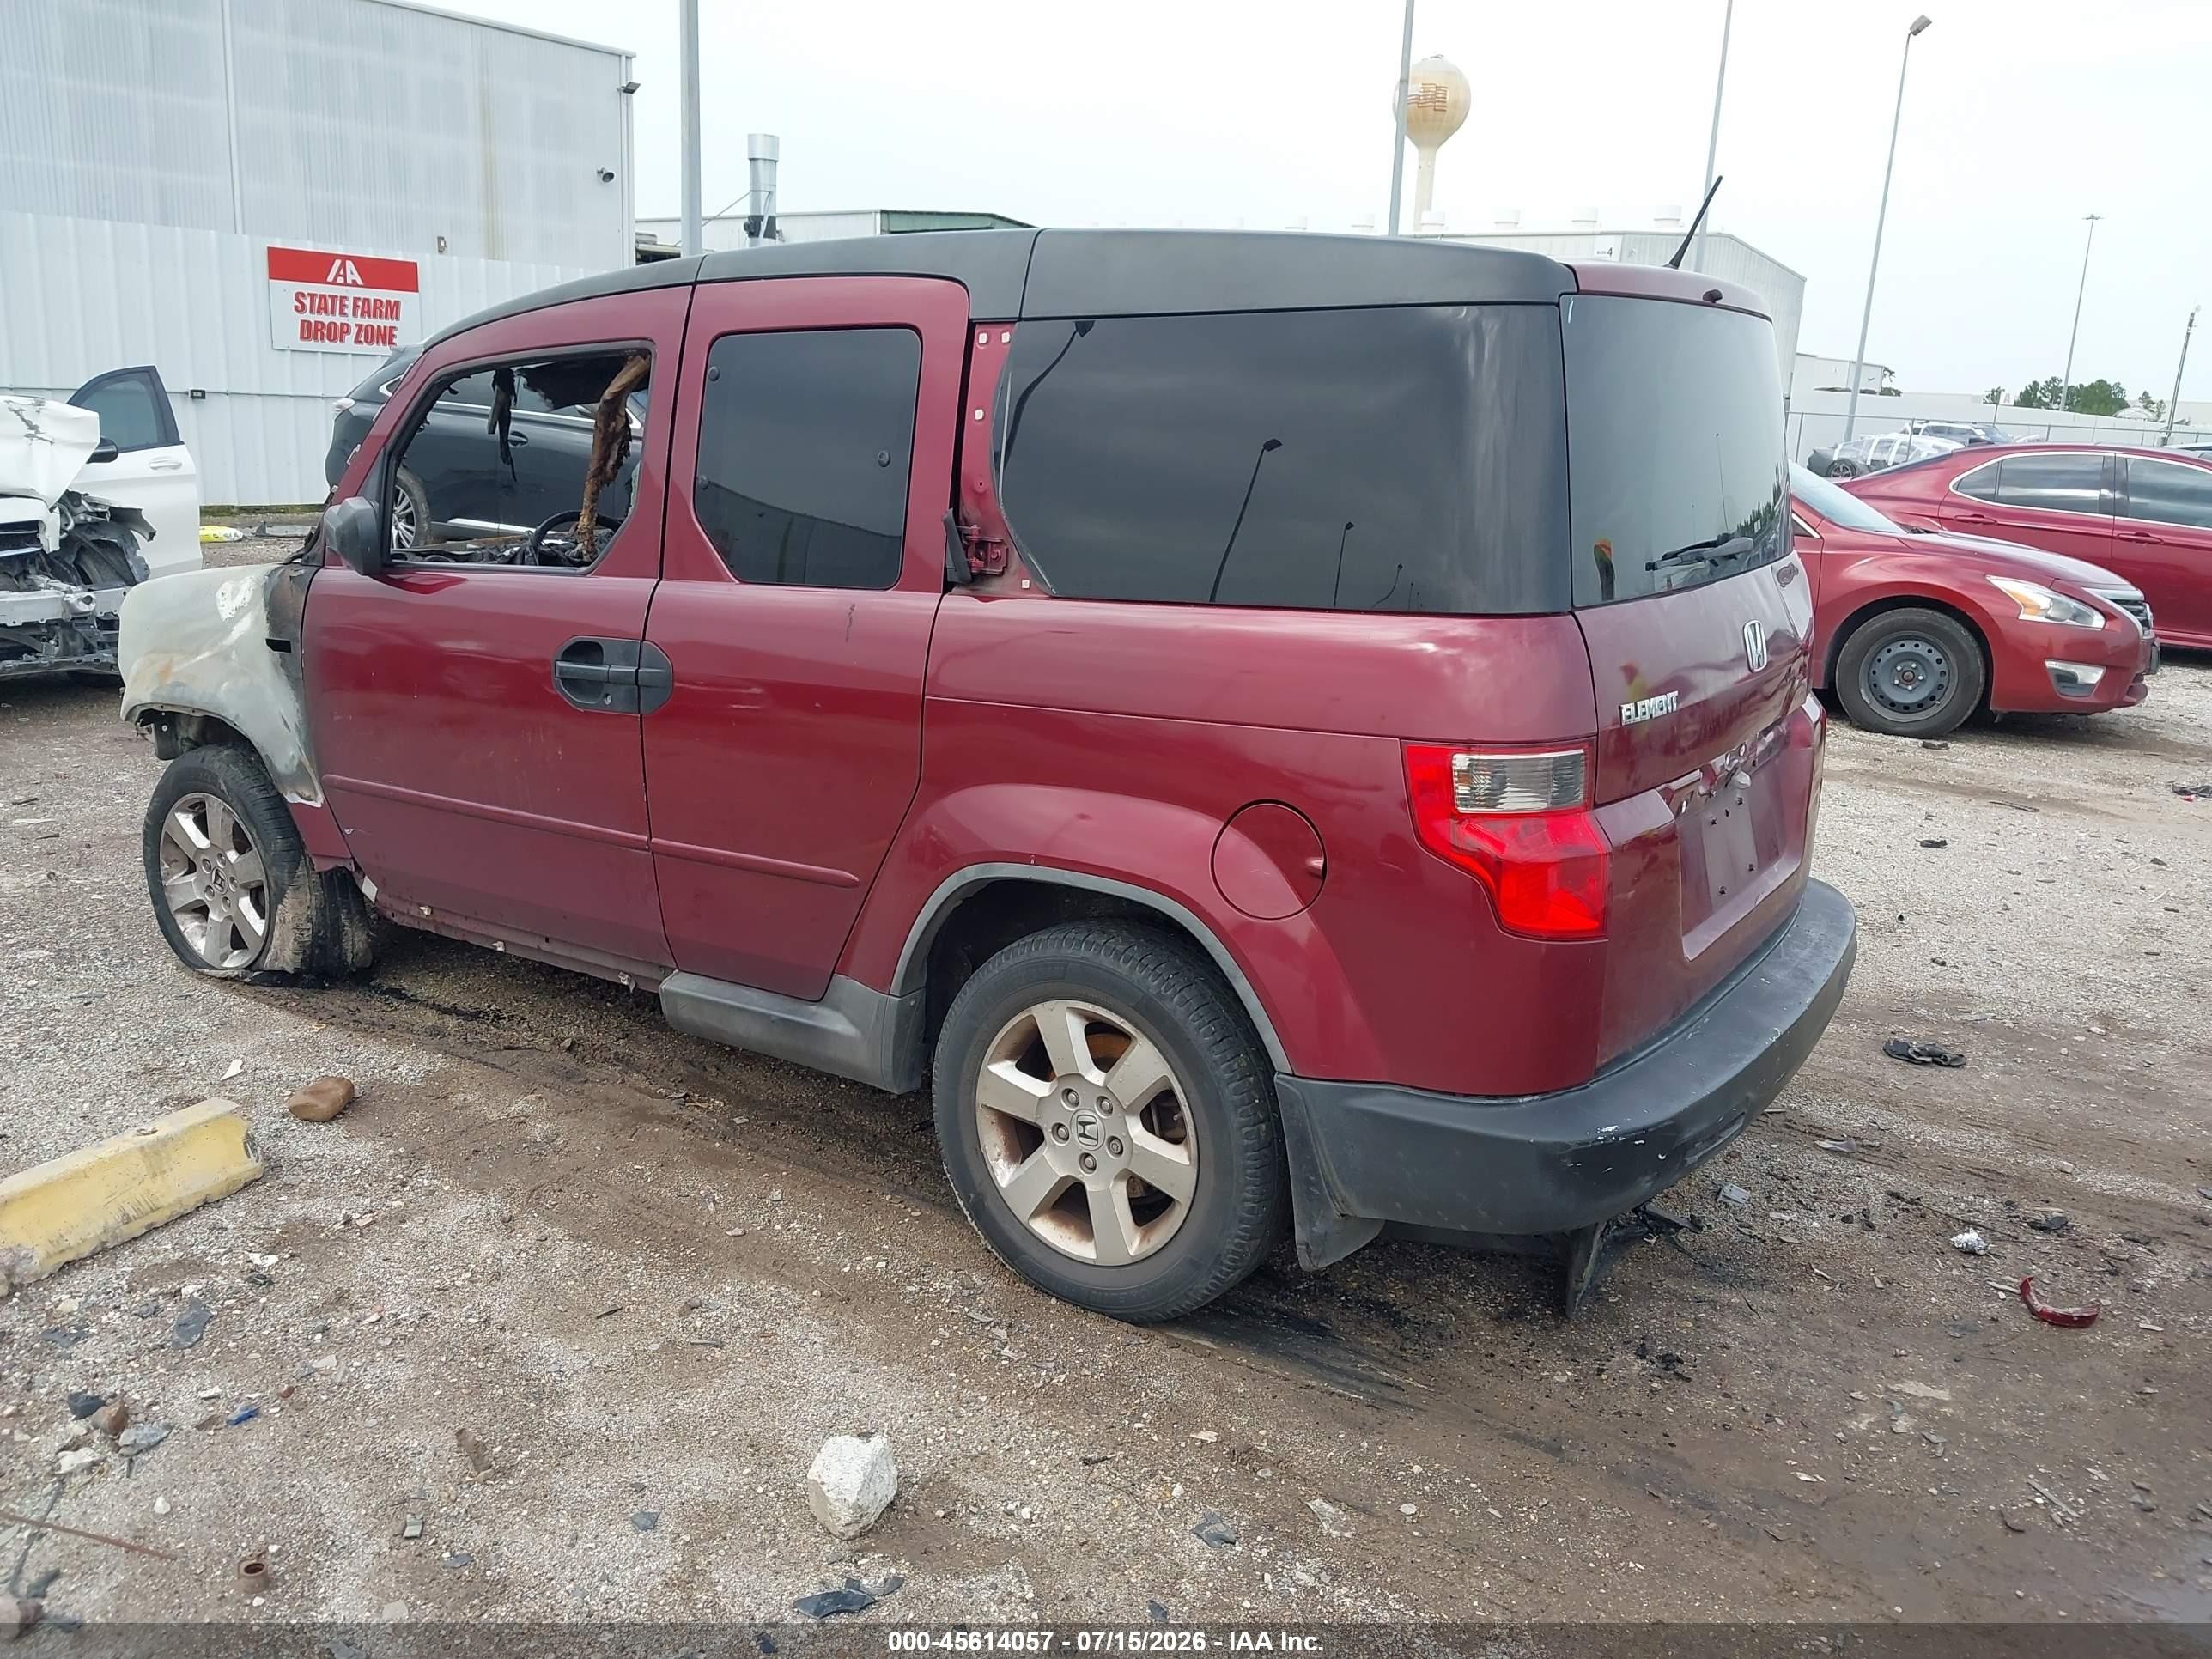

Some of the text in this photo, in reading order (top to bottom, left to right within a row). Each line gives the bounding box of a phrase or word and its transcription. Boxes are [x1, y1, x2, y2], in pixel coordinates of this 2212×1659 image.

[294, 291, 401, 321] STATE FARM
[300, 319, 398, 347] DROP ZONE
[1620, 690, 1679, 726] ELEMENT
